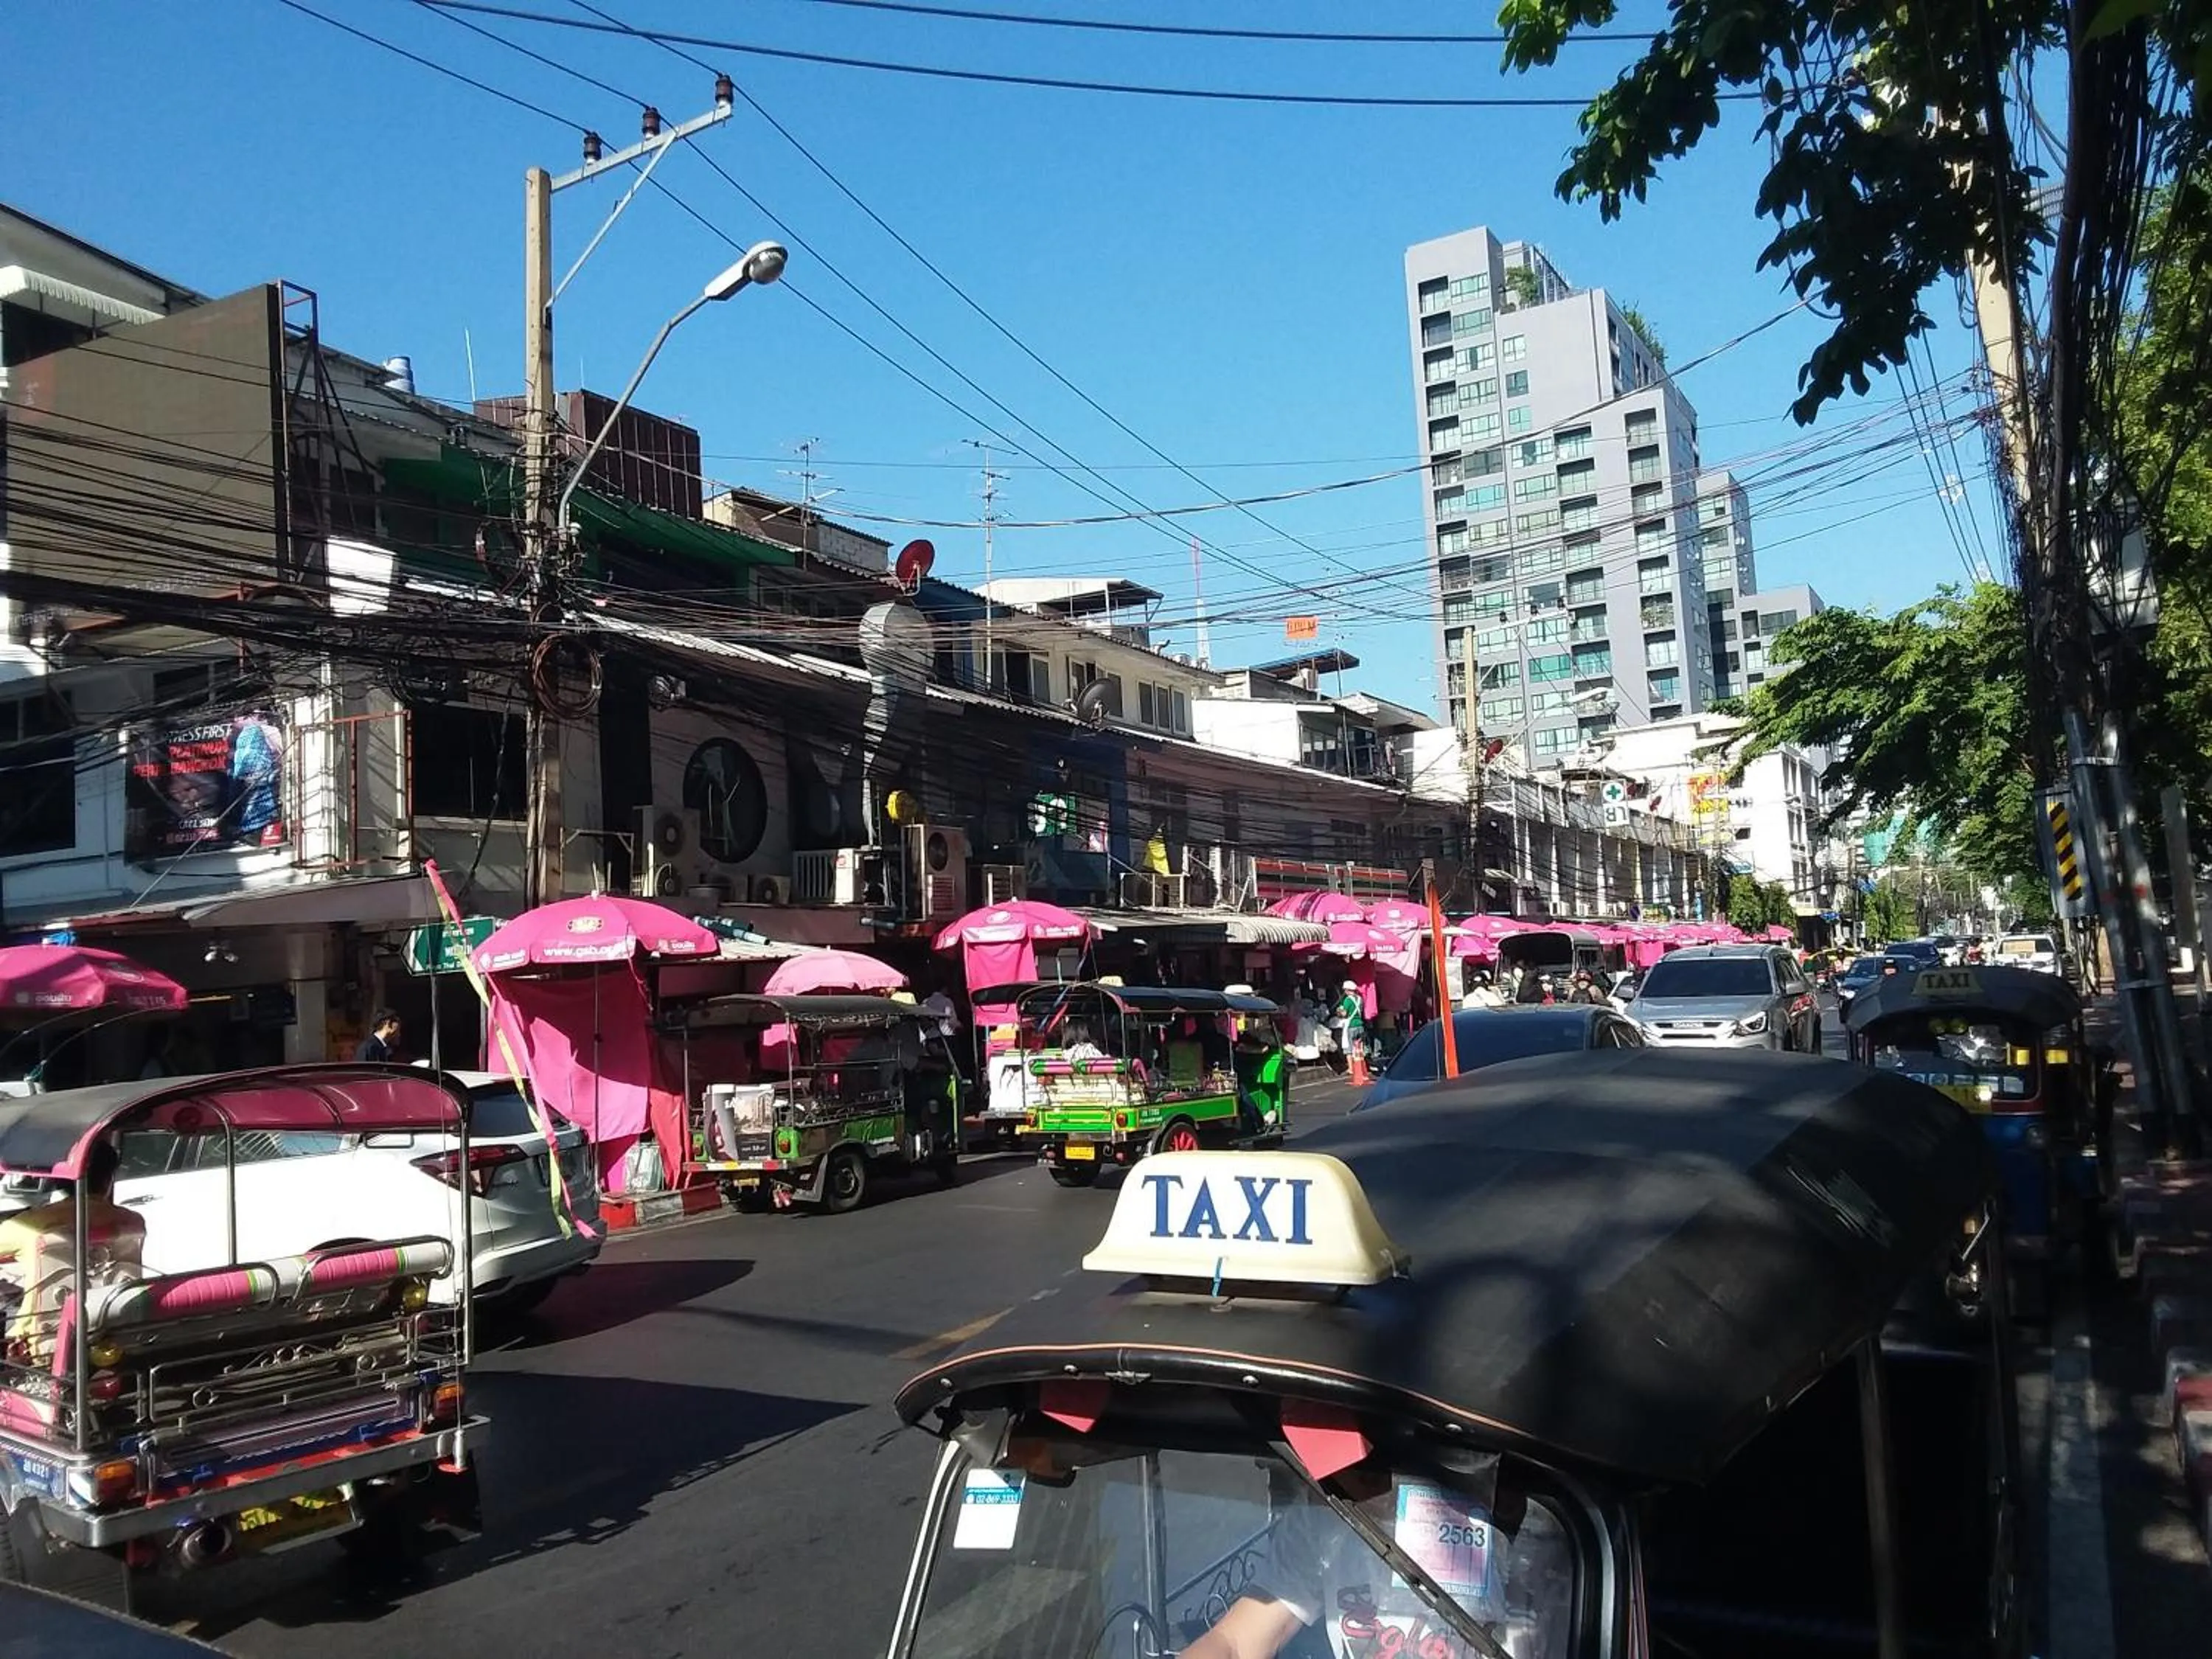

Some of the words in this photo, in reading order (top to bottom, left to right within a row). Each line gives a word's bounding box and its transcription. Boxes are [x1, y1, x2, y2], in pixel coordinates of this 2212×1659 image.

[1922, 973, 1971, 989] TAXI
[1141, 1175, 1313, 1245] TAXI
[1439, 1523, 1486, 1548] 2563
